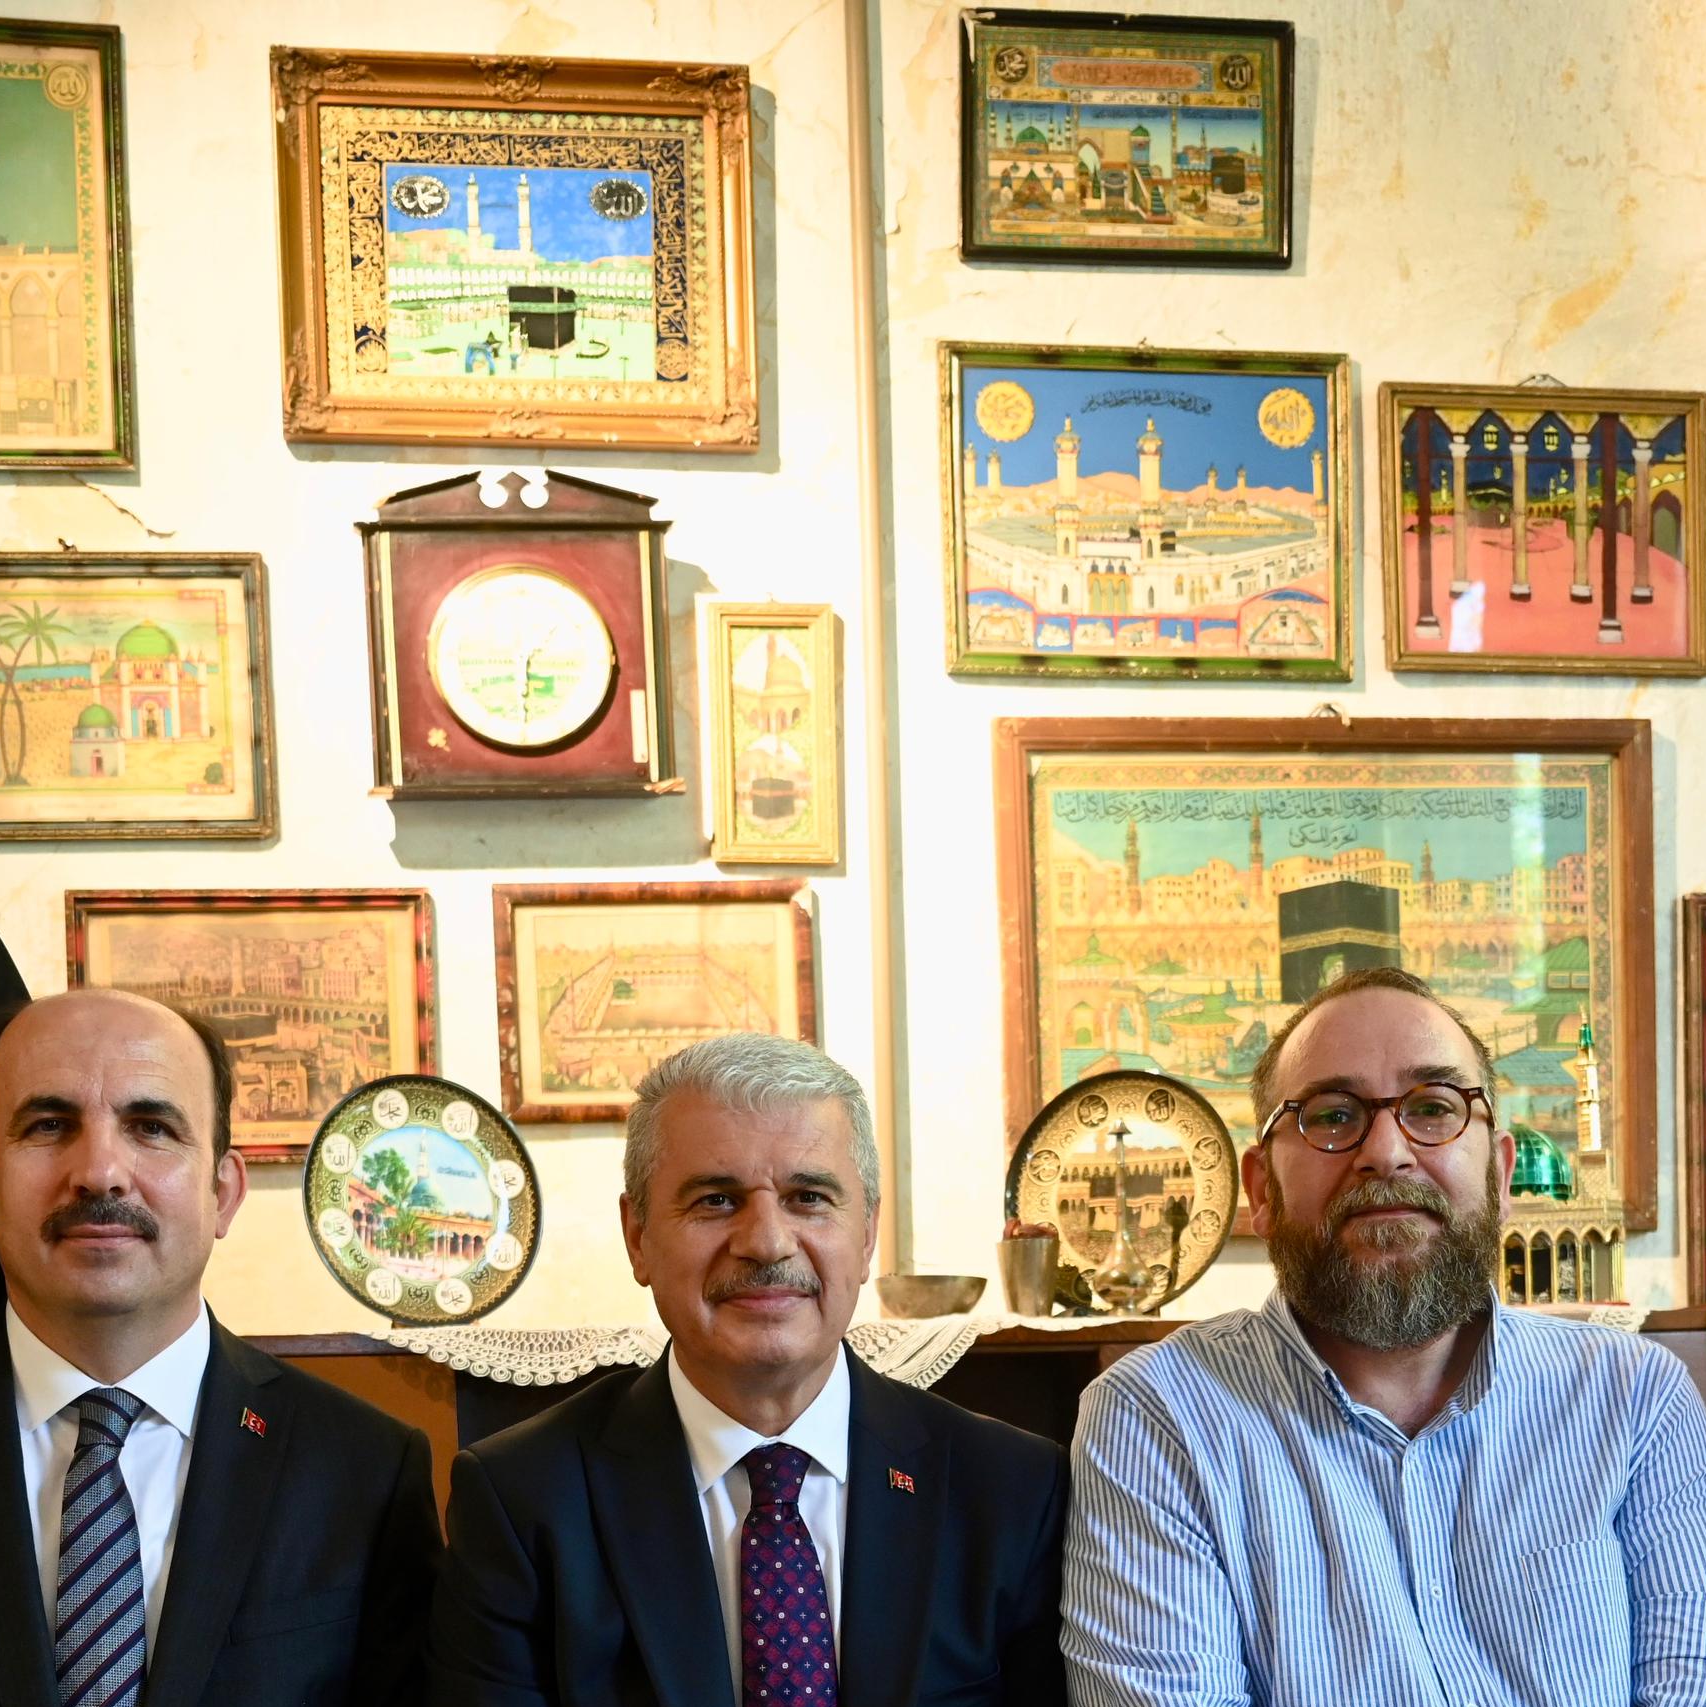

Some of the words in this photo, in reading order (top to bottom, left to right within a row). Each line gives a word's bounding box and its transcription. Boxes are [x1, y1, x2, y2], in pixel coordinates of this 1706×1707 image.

[52, 70, 80, 99] الله
[1222, 57, 1252, 89] الله
[399, 182, 444, 214] محمد
[603, 186, 640, 216] الله
[380, 1101, 403, 1121] محمد
[448, 1108, 474, 1134] الله
[328, 1142, 351, 1168] الله
[373, 1276, 397, 1302] الله
